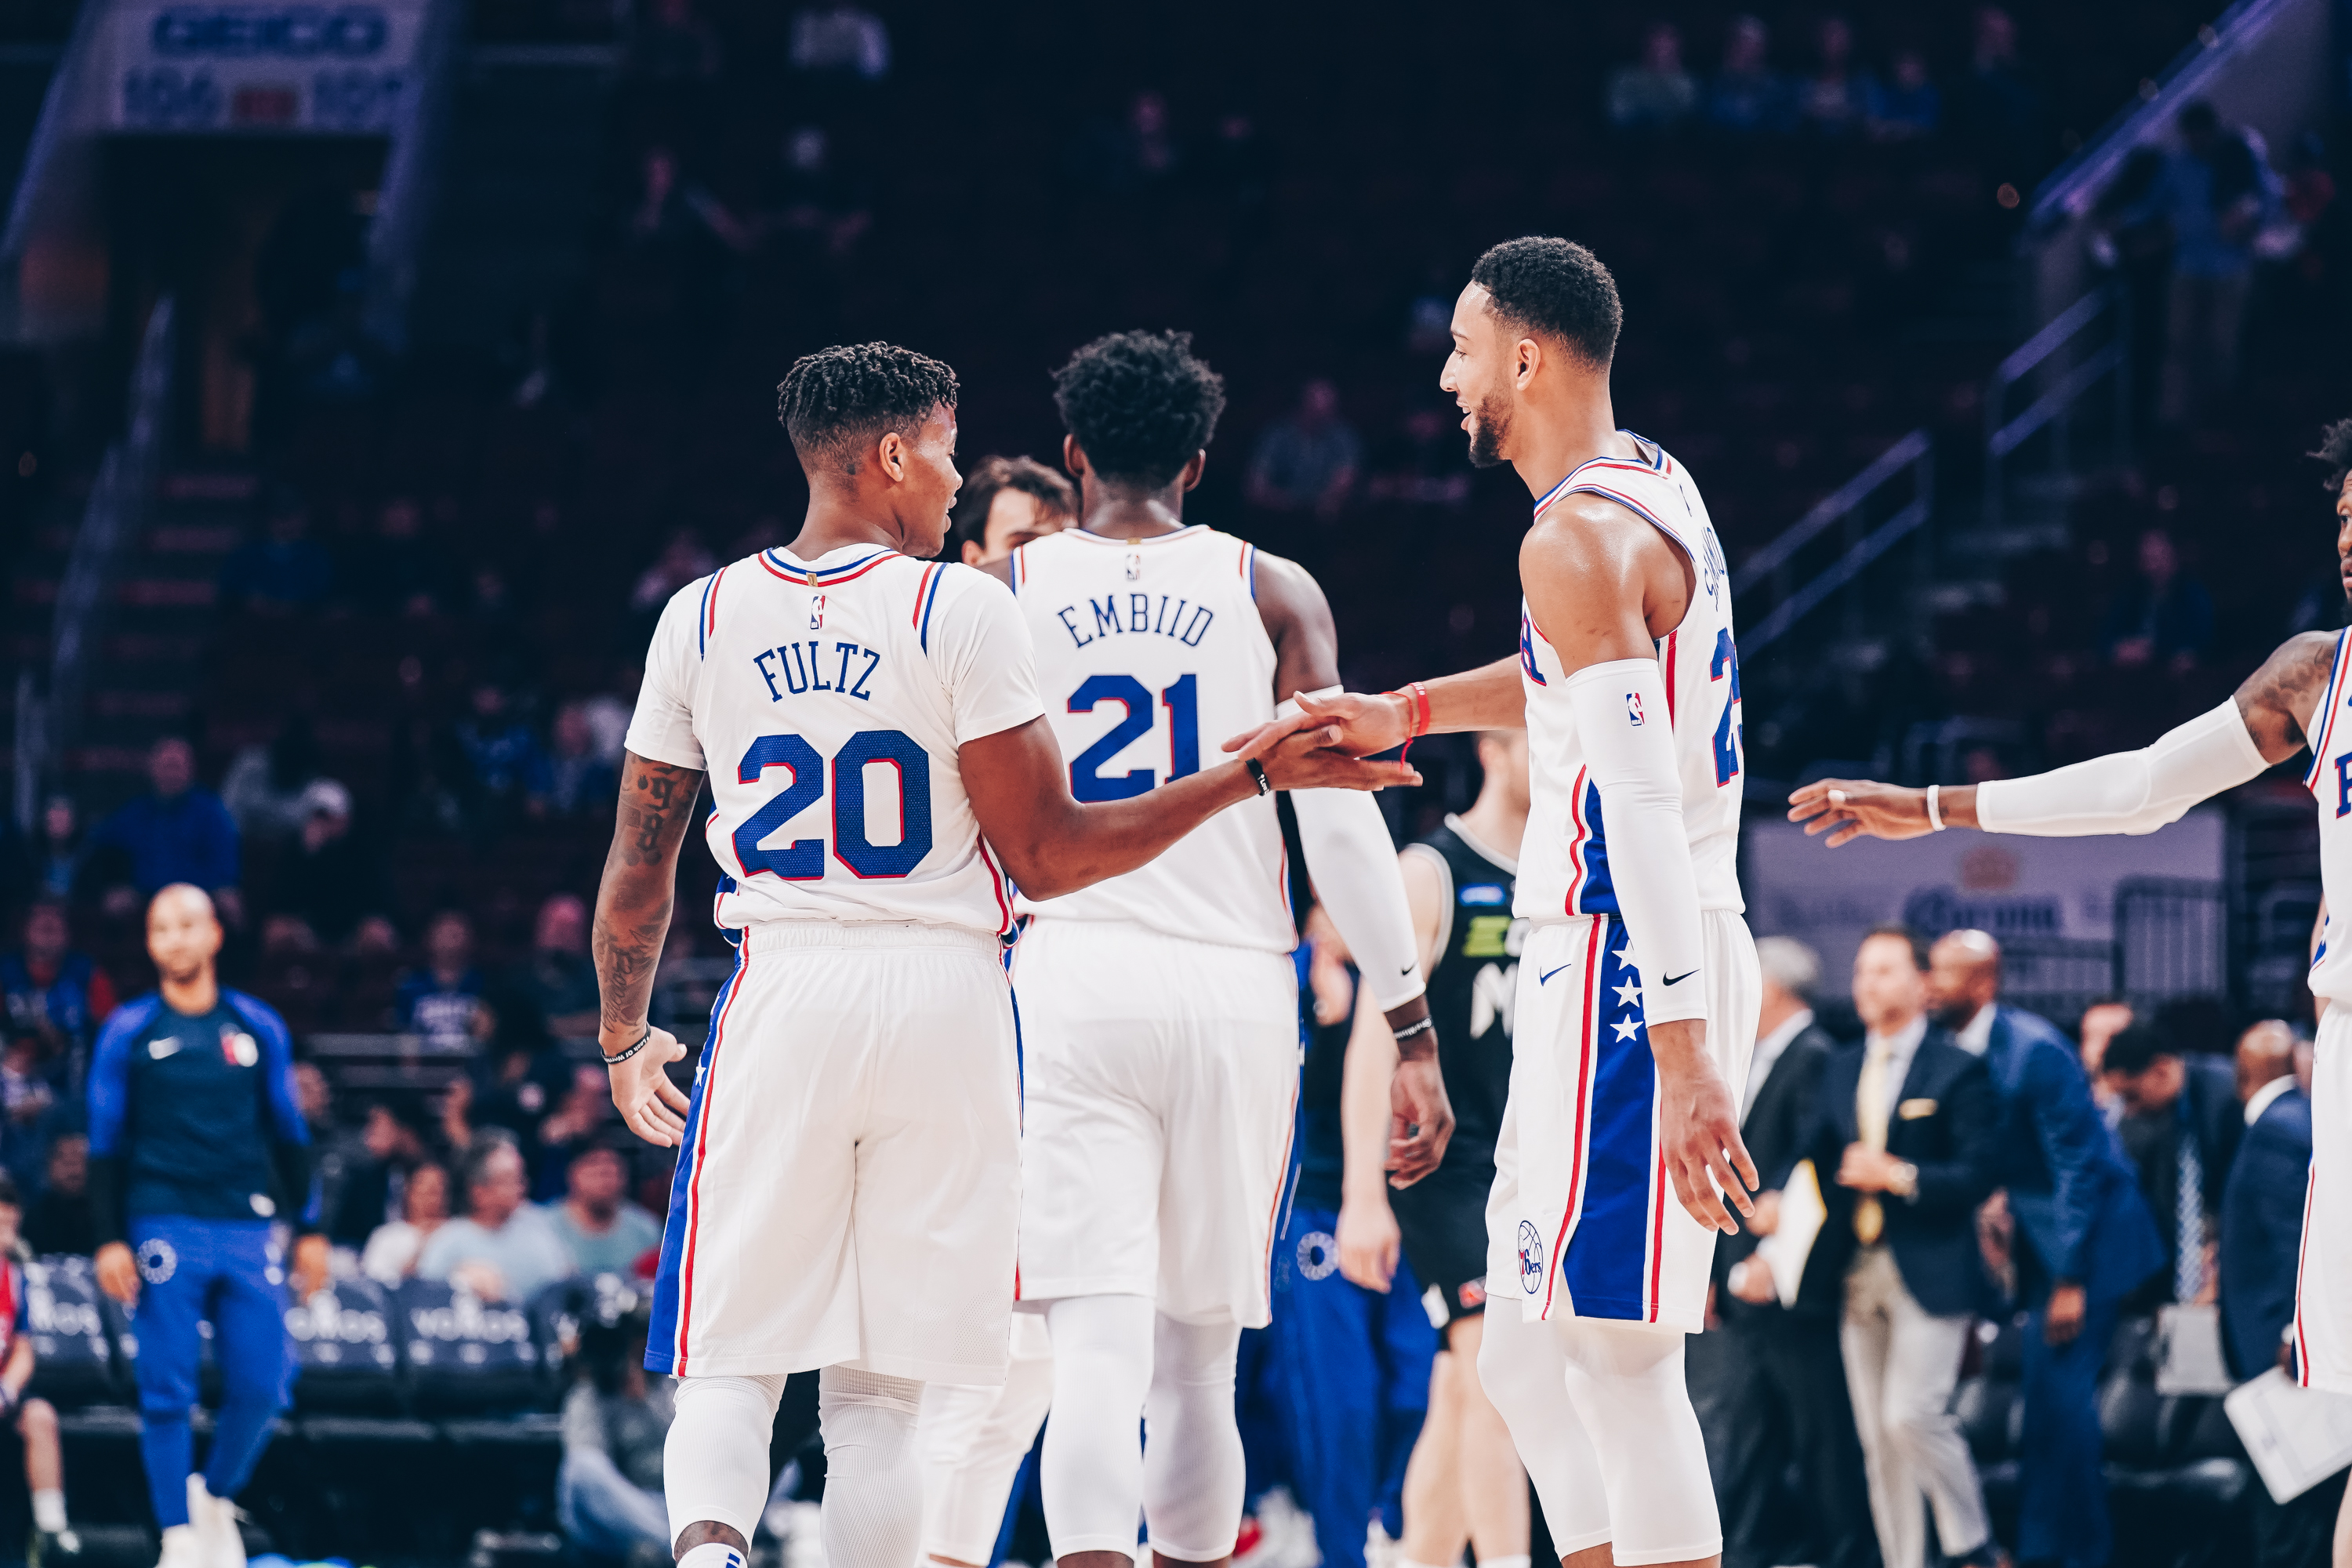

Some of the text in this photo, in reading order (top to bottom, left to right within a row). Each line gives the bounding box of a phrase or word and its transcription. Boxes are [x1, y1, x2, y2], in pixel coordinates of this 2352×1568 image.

[154, 11, 386, 56] GEICO
[1057, 593, 1214, 649] EMBIID
[753, 641, 880, 702] FULTZ
[1067, 673, 1200, 804] 21
[731, 729, 933, 881] 20
[1519, 1249, 1541, 1276] 76ers
